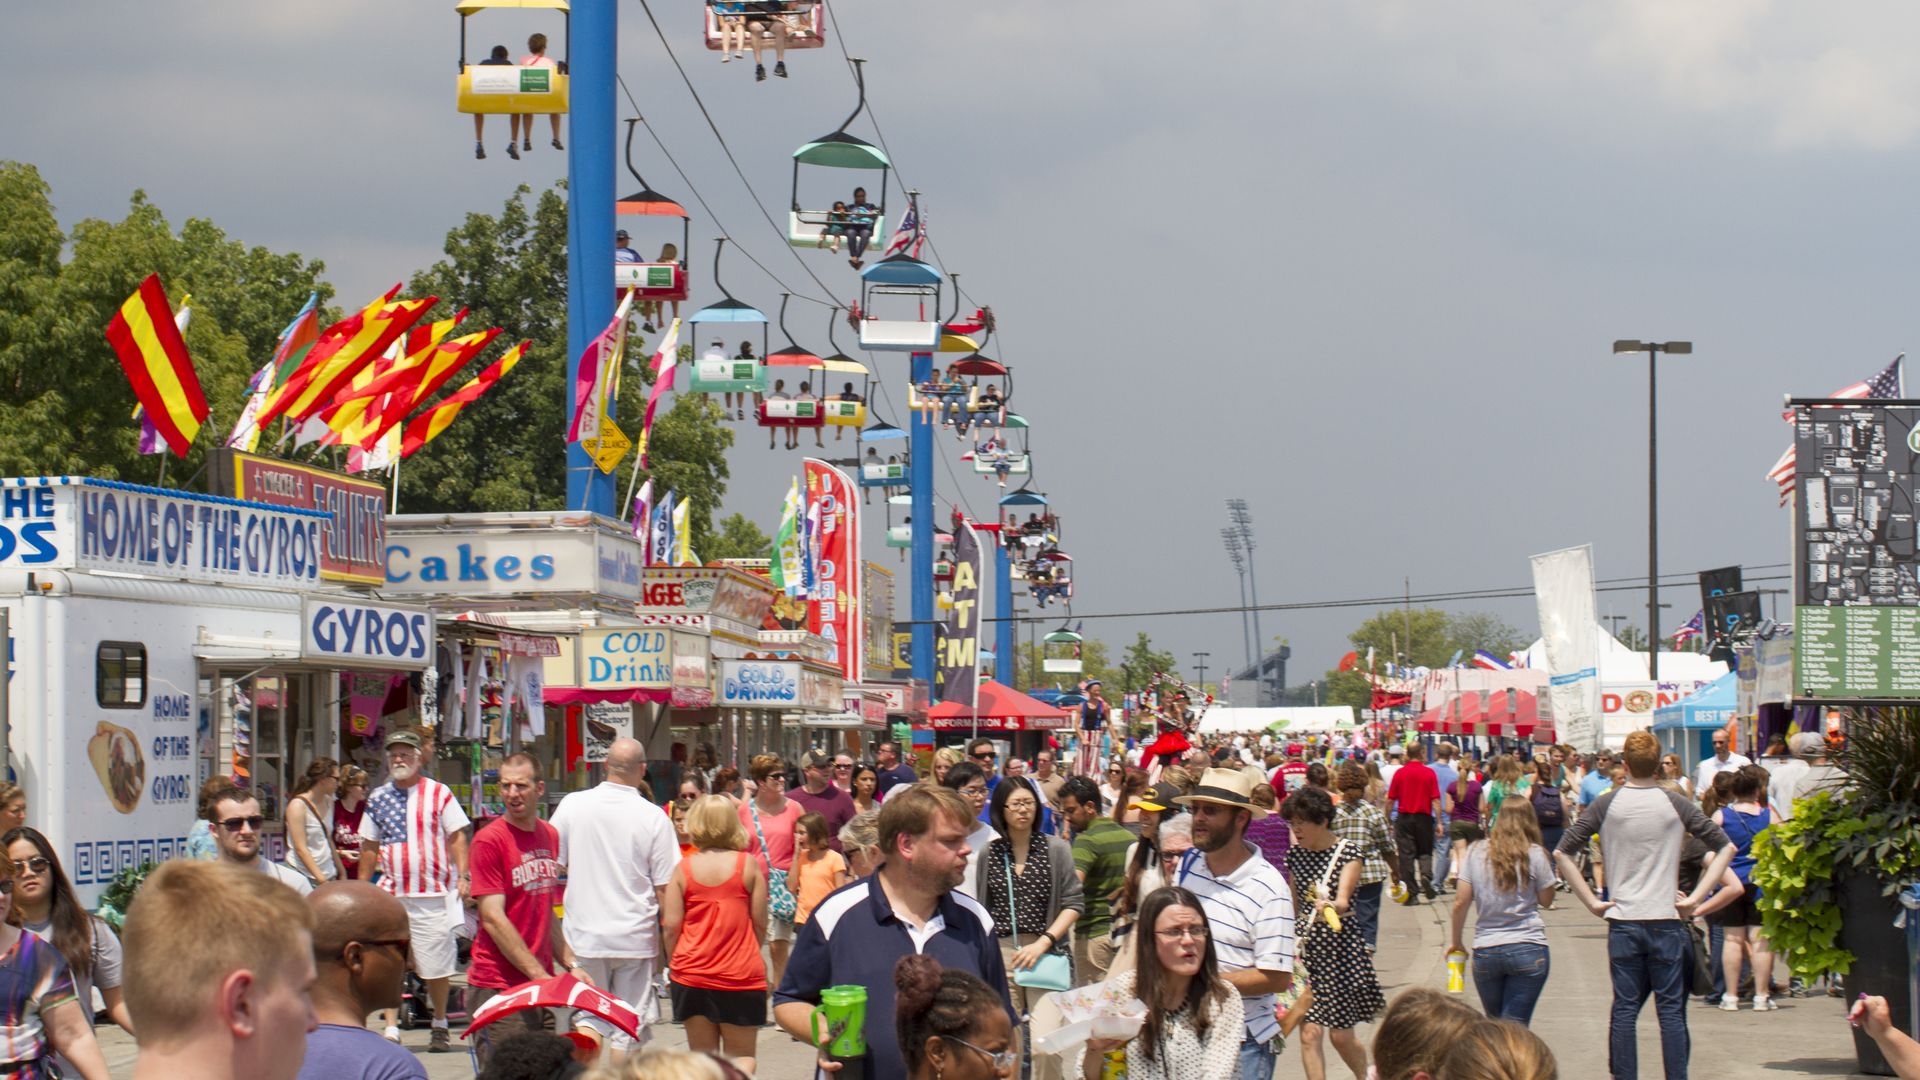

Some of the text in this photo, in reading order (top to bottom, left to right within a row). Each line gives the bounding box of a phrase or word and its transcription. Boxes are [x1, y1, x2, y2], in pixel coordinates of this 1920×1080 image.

[82, 491, 317, 579] HOME OF THE GYROS
[386, 544, 555, 582] Cakes
[947, 561, 977, 667] ATM
[312, 606, 427, 659] GYROS
[603, 632, 665, 653] COLD
[589, 656, 671, 682] Drinks
[738, 664, 785, 684] COLD
[725, 677, 795, 700] DRINKS
[154, 695, 190, 717] HOME
[1695, 710, 1718, 722] BEST
[153, 736, 190, 756] OF THE
[152, 775, 190, 800] GYROS
